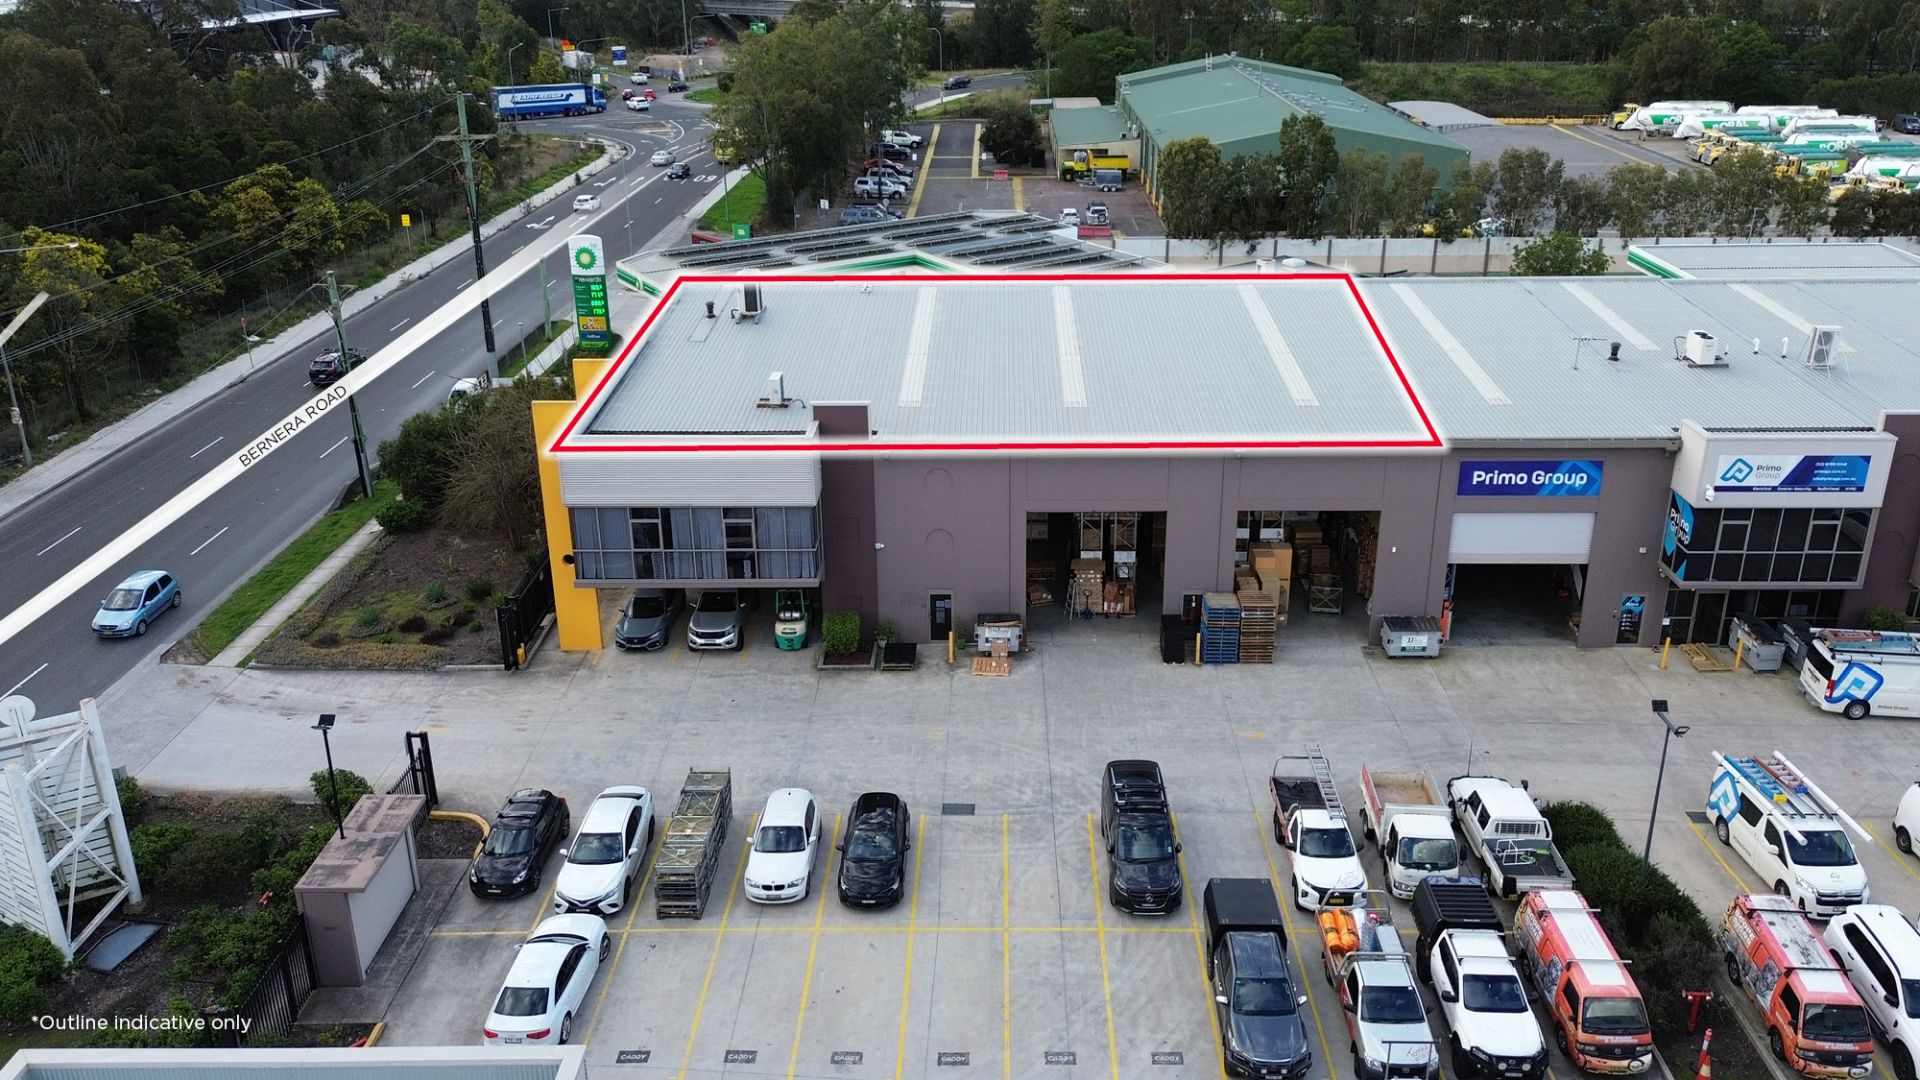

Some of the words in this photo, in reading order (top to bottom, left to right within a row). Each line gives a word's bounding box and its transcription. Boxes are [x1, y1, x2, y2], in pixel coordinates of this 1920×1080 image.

[1756, 464, 1782, 472] Primo
[1472, 470, 1528, 485] Primo
[1531, 470, 1588, 487] Group
[1755, 472, 1780, 480] Group
[620, 1053, 648, 1061] CADDY
[727, 1053, 755, 1061] CADDY
